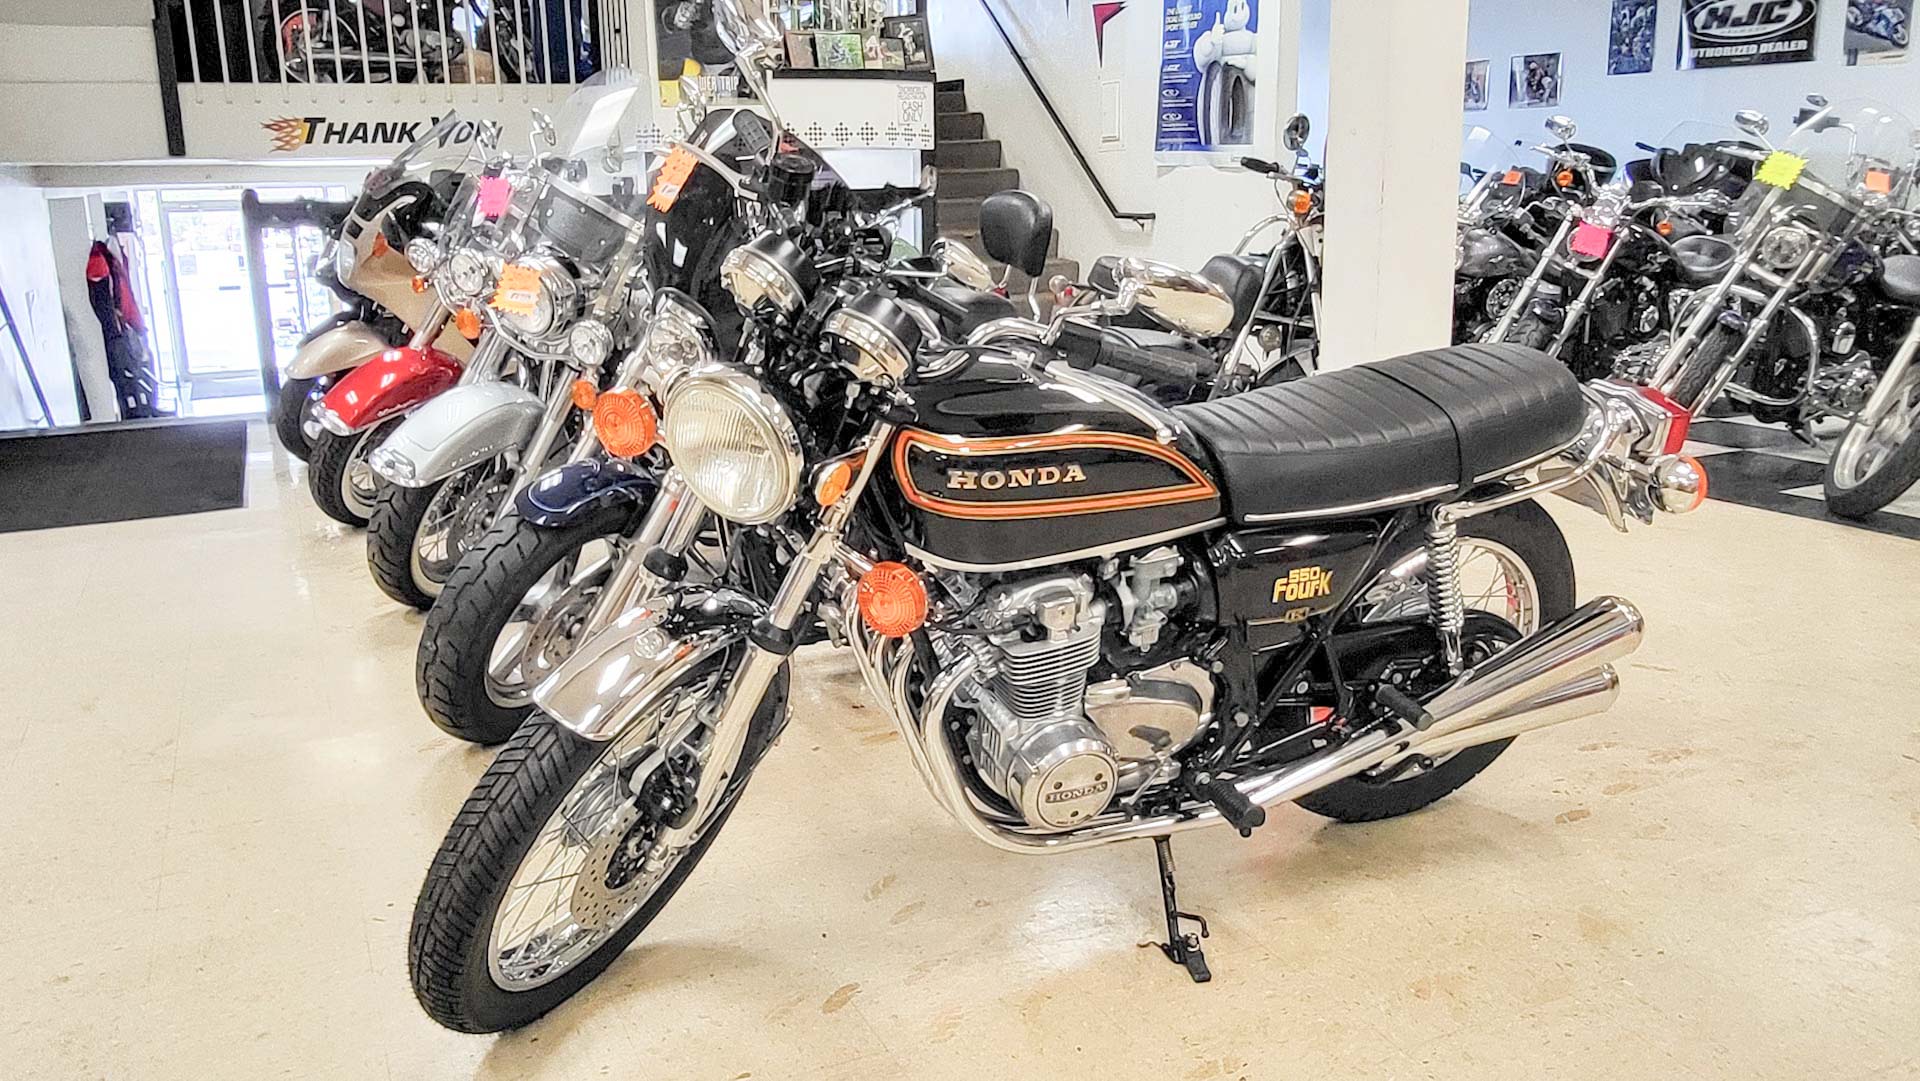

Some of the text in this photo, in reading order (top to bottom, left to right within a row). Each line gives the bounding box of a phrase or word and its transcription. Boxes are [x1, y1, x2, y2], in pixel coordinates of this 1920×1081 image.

[1701, 0, 1793, 30] HJC
[1691, 40, 1808, 58] UTHORIZED DEALER
[719, 75, 739, 92] TRIP
[902, 101, 923, 111] CASH
[903, 110, 923, 122] ONLY
[303, 117, 422, 144] THANK
[946, 464, 1087, 490] HONDA
[1288, 566, 1321, 583] 550
[1047, 781, 1108, 802] HONDA
